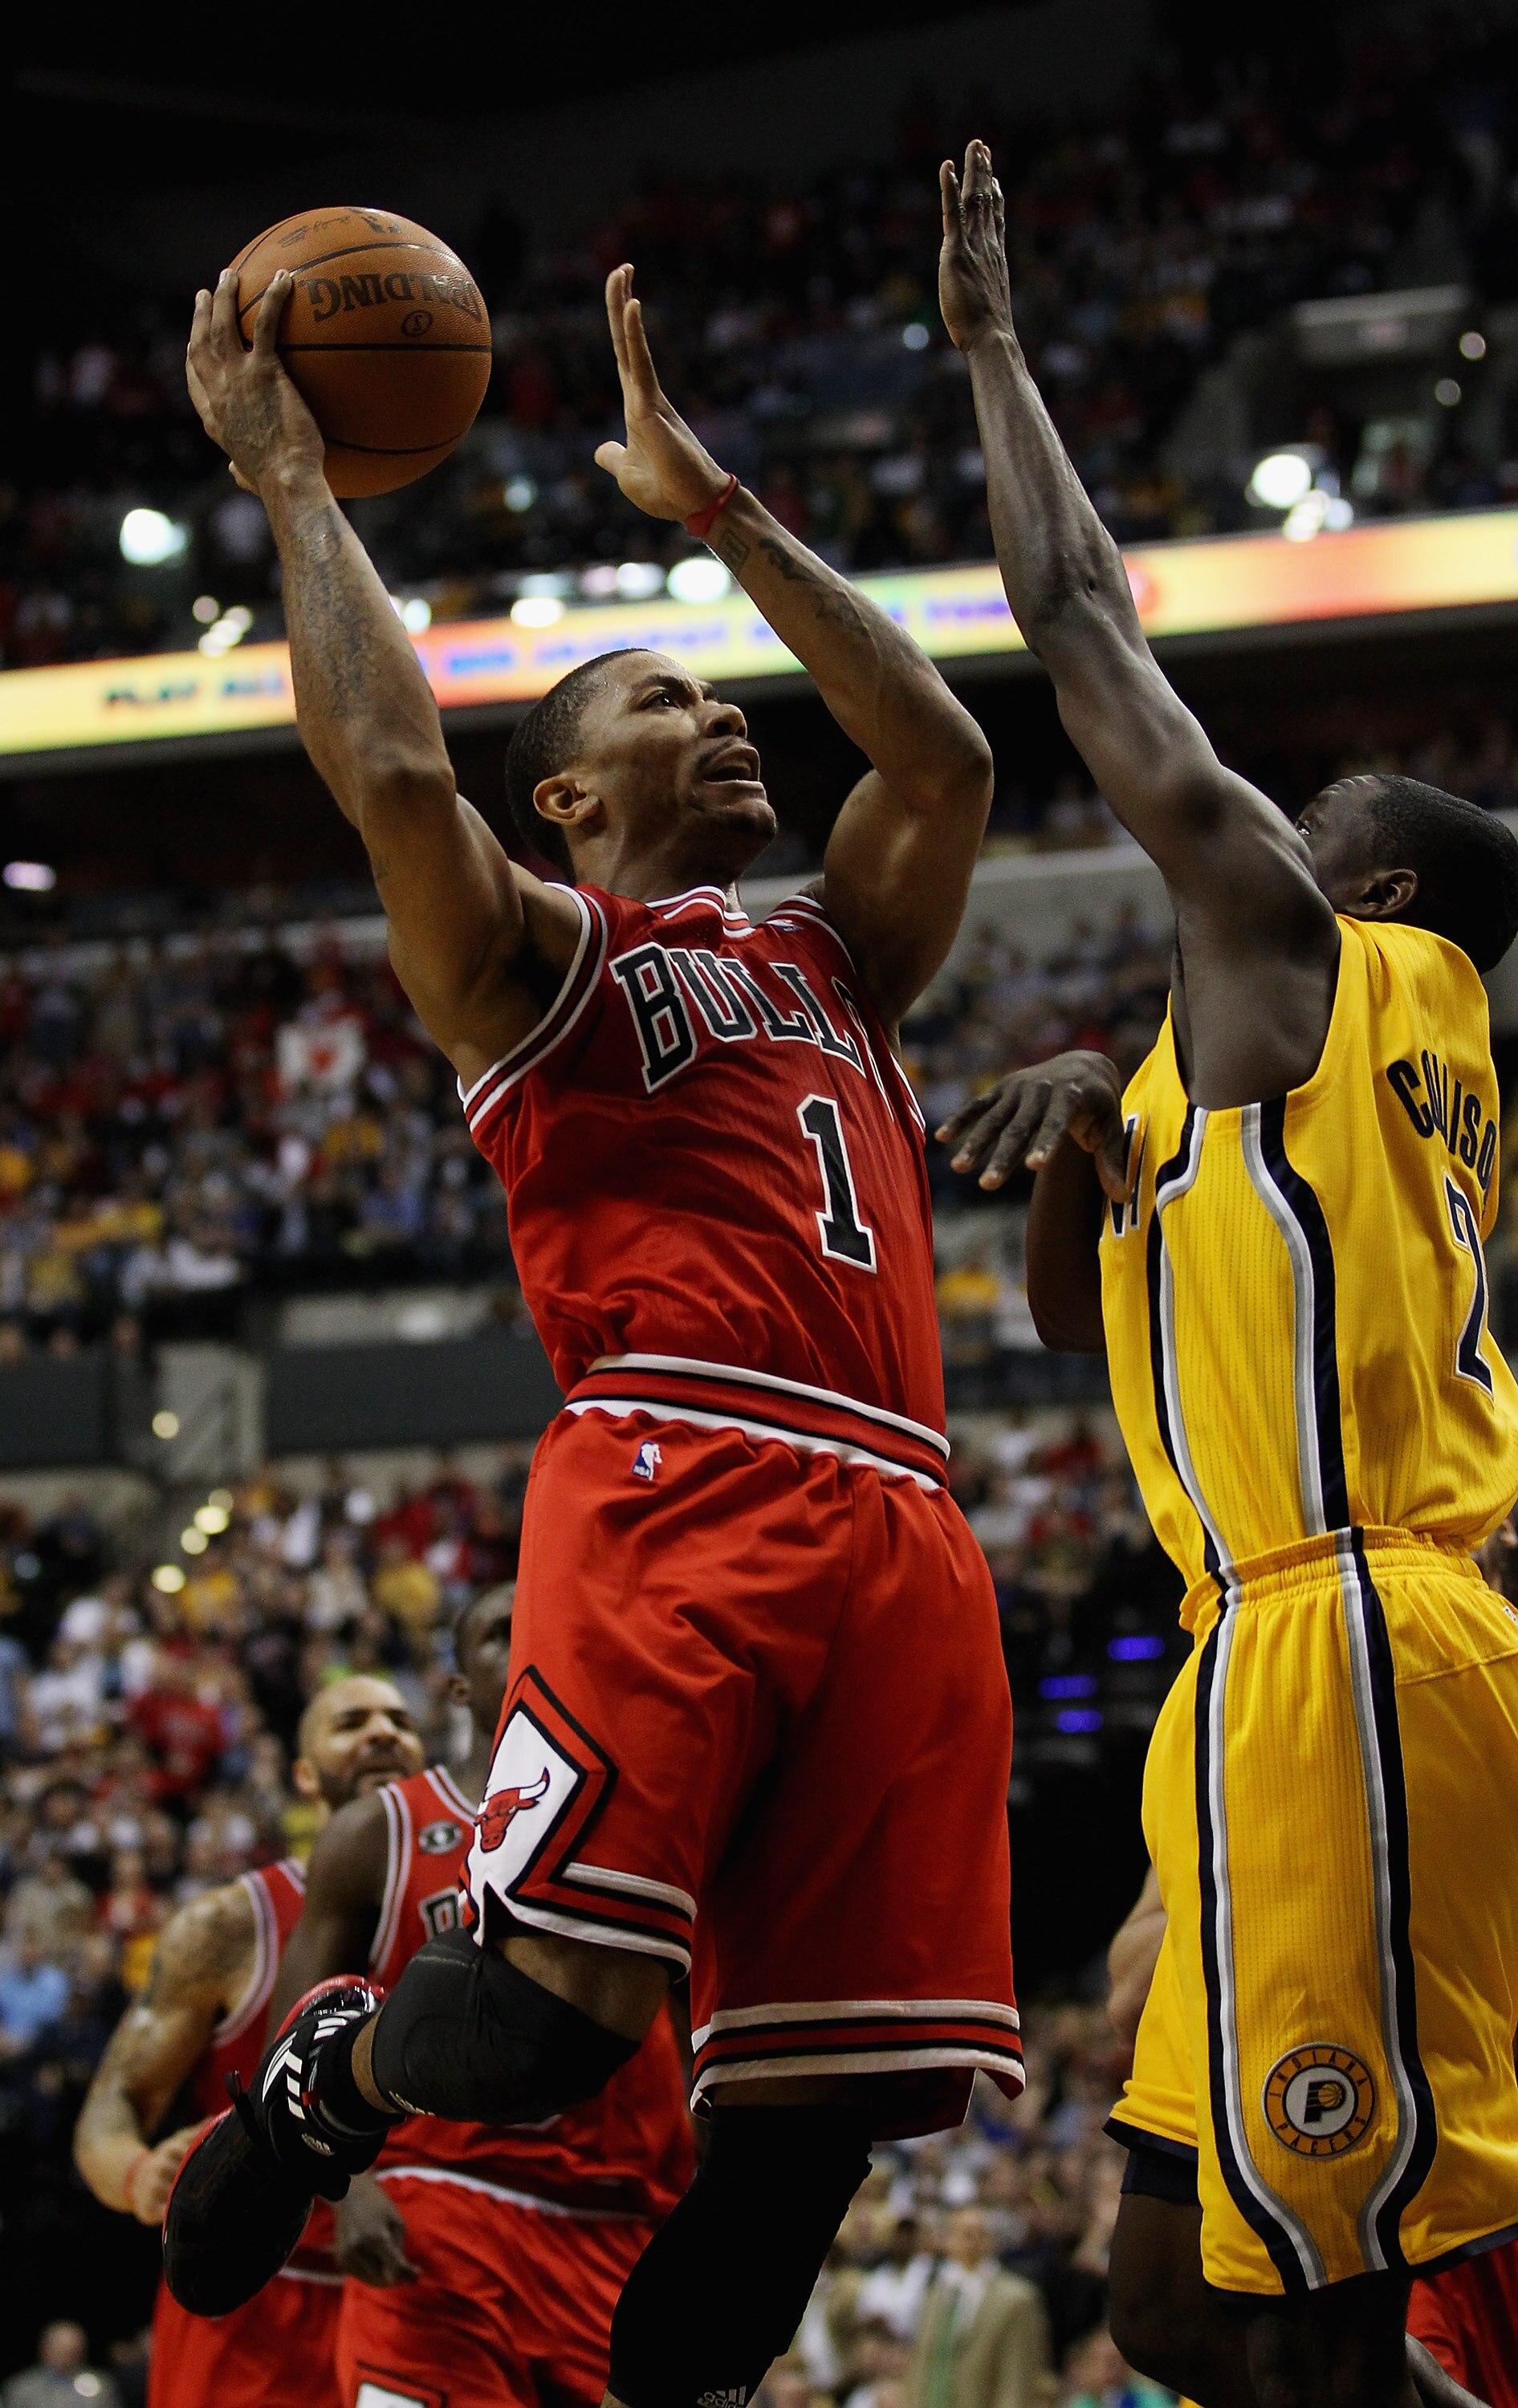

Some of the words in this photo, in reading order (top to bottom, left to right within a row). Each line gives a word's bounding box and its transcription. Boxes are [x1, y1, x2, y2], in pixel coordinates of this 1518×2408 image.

[796, 1093, 877, 1274] 1
[1269, 2051, 1369, 2098] INDIANA
[1276, 2116, 1366, 2155] PACERS
